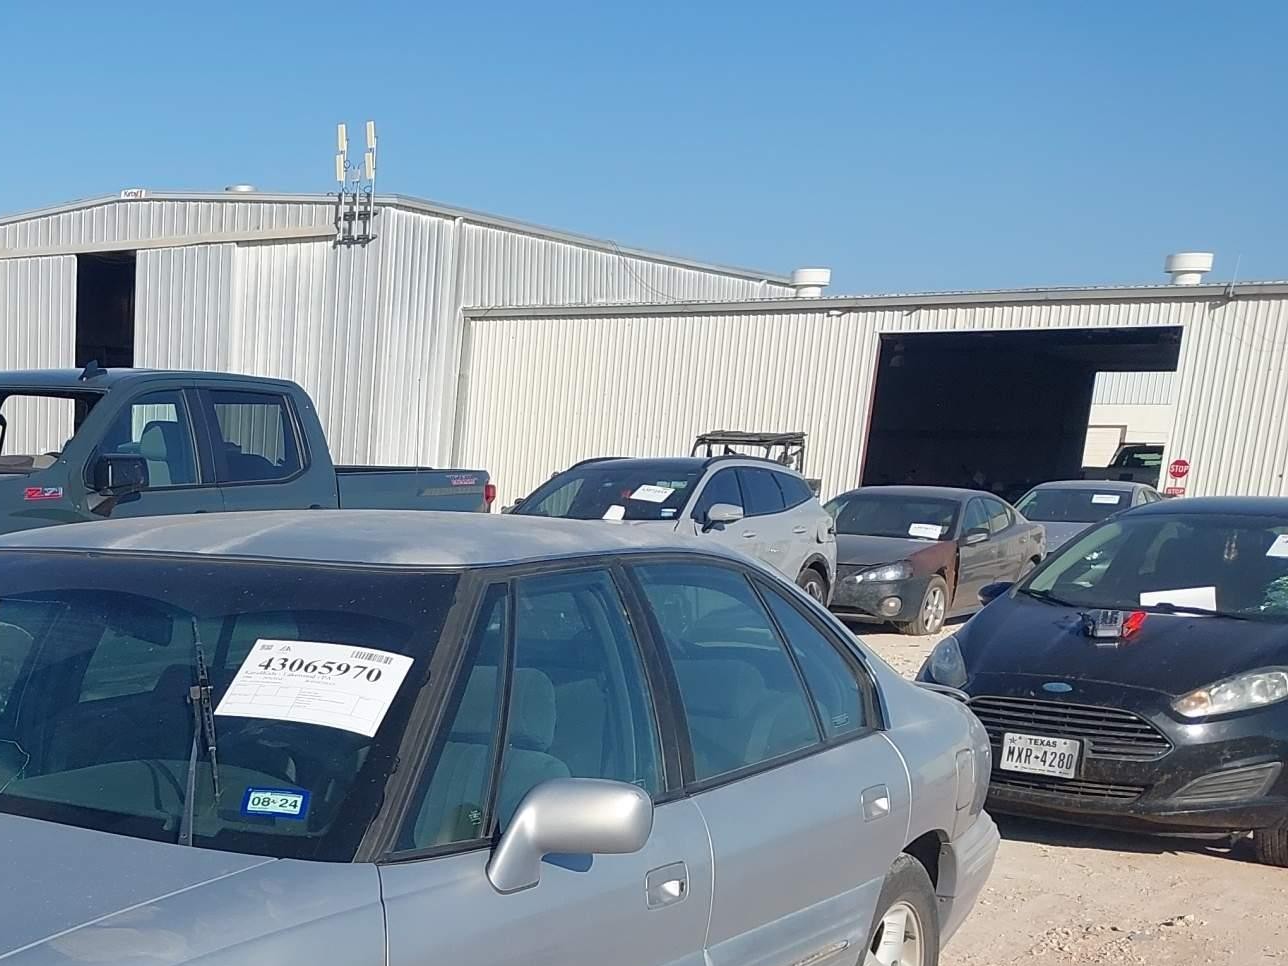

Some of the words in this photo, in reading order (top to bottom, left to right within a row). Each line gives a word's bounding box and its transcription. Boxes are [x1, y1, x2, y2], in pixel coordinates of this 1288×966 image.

[1169, 464, 1189, 473] STOP
[24, 487, 63, 500] Z71
[258, 656, 382, 683] 43065970
[1028, 737, 1057, 748] TEXAS
